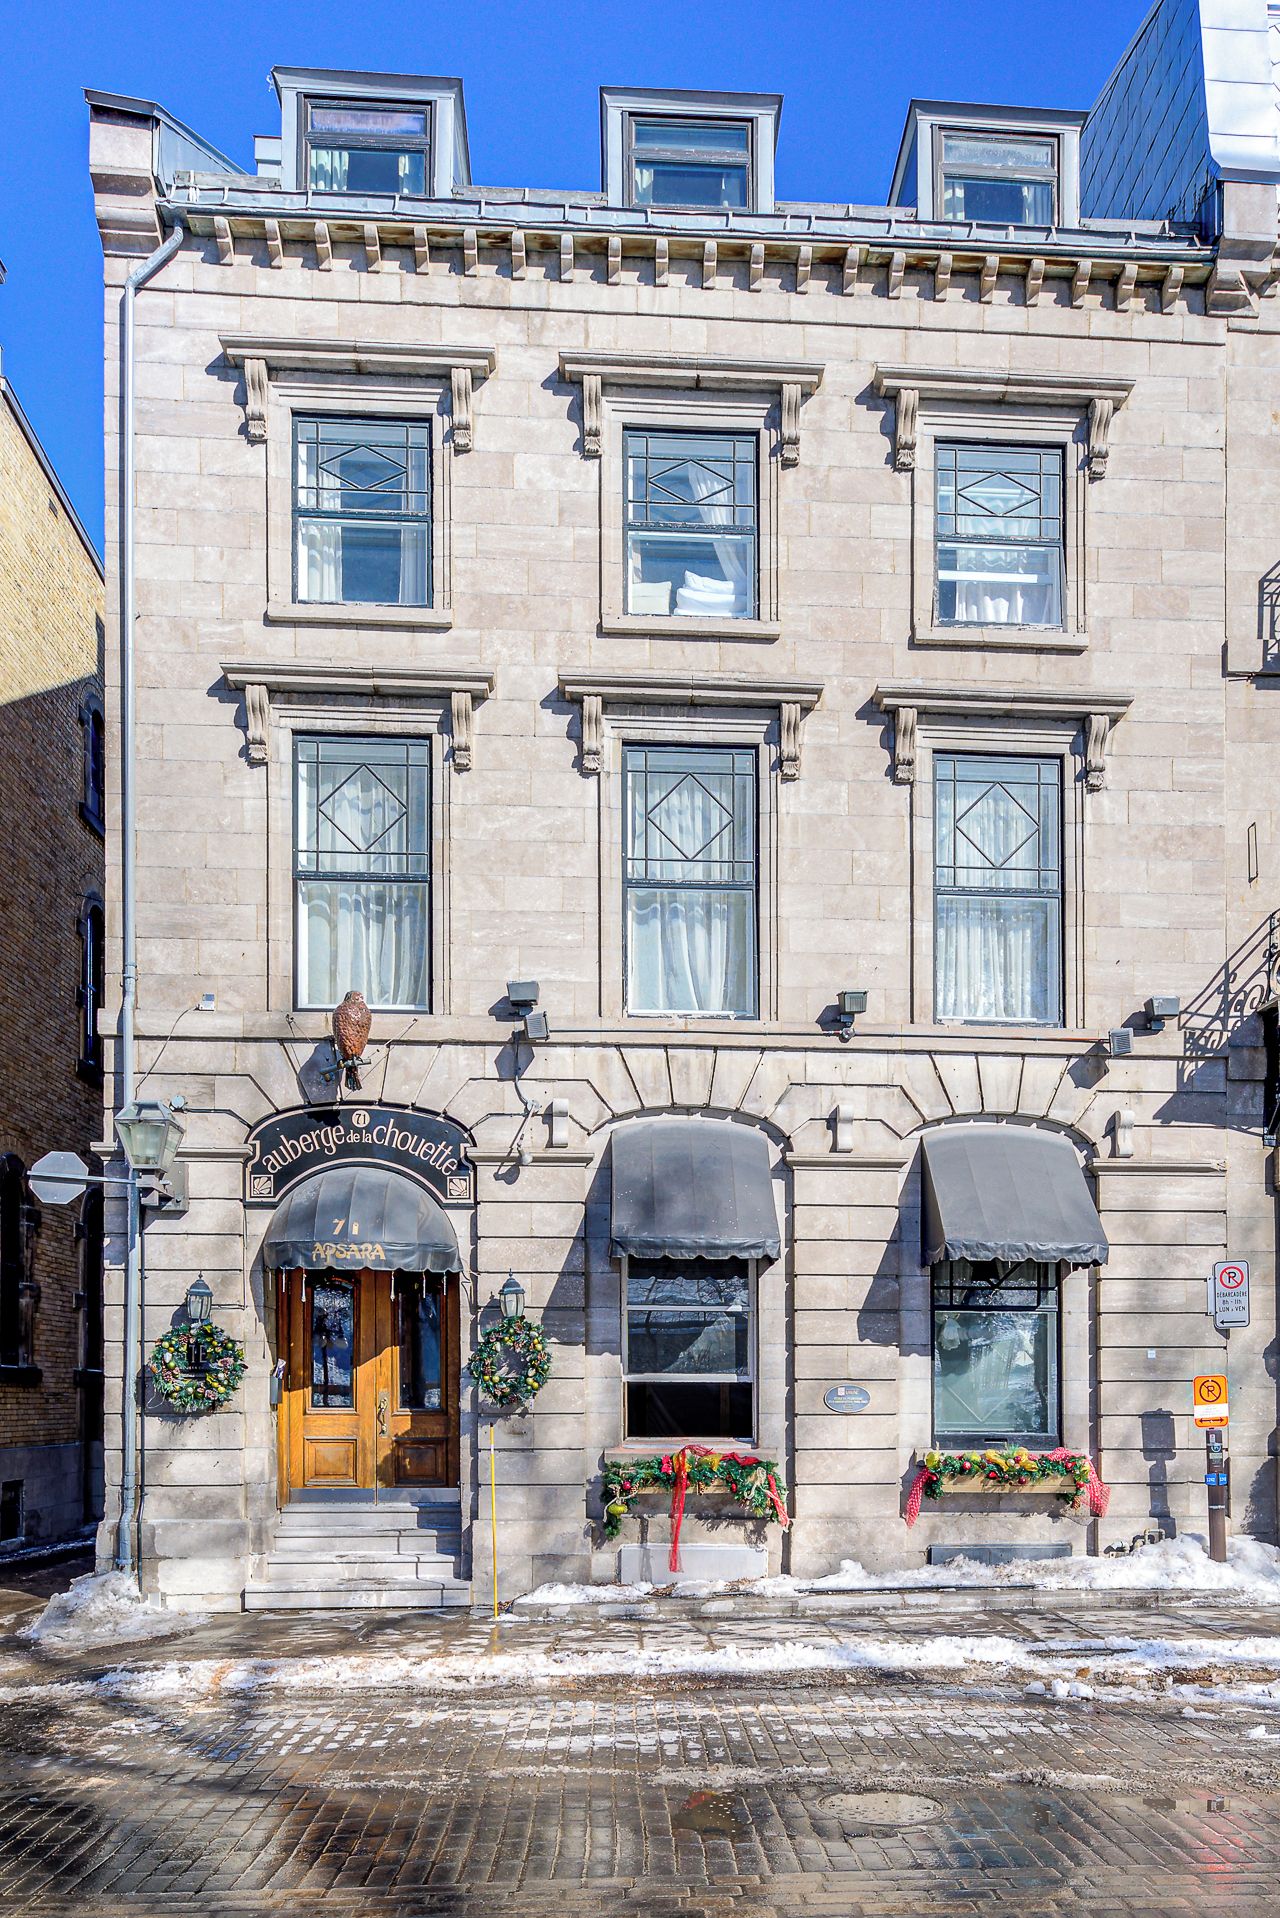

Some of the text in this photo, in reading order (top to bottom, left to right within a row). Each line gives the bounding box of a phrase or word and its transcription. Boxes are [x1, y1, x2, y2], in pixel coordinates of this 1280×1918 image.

[355, 1113, 366, 1125] 71
[262, 1119, 457, 1176] auberge de la chouette
[312, 1242, 386, 1264] APSARA
